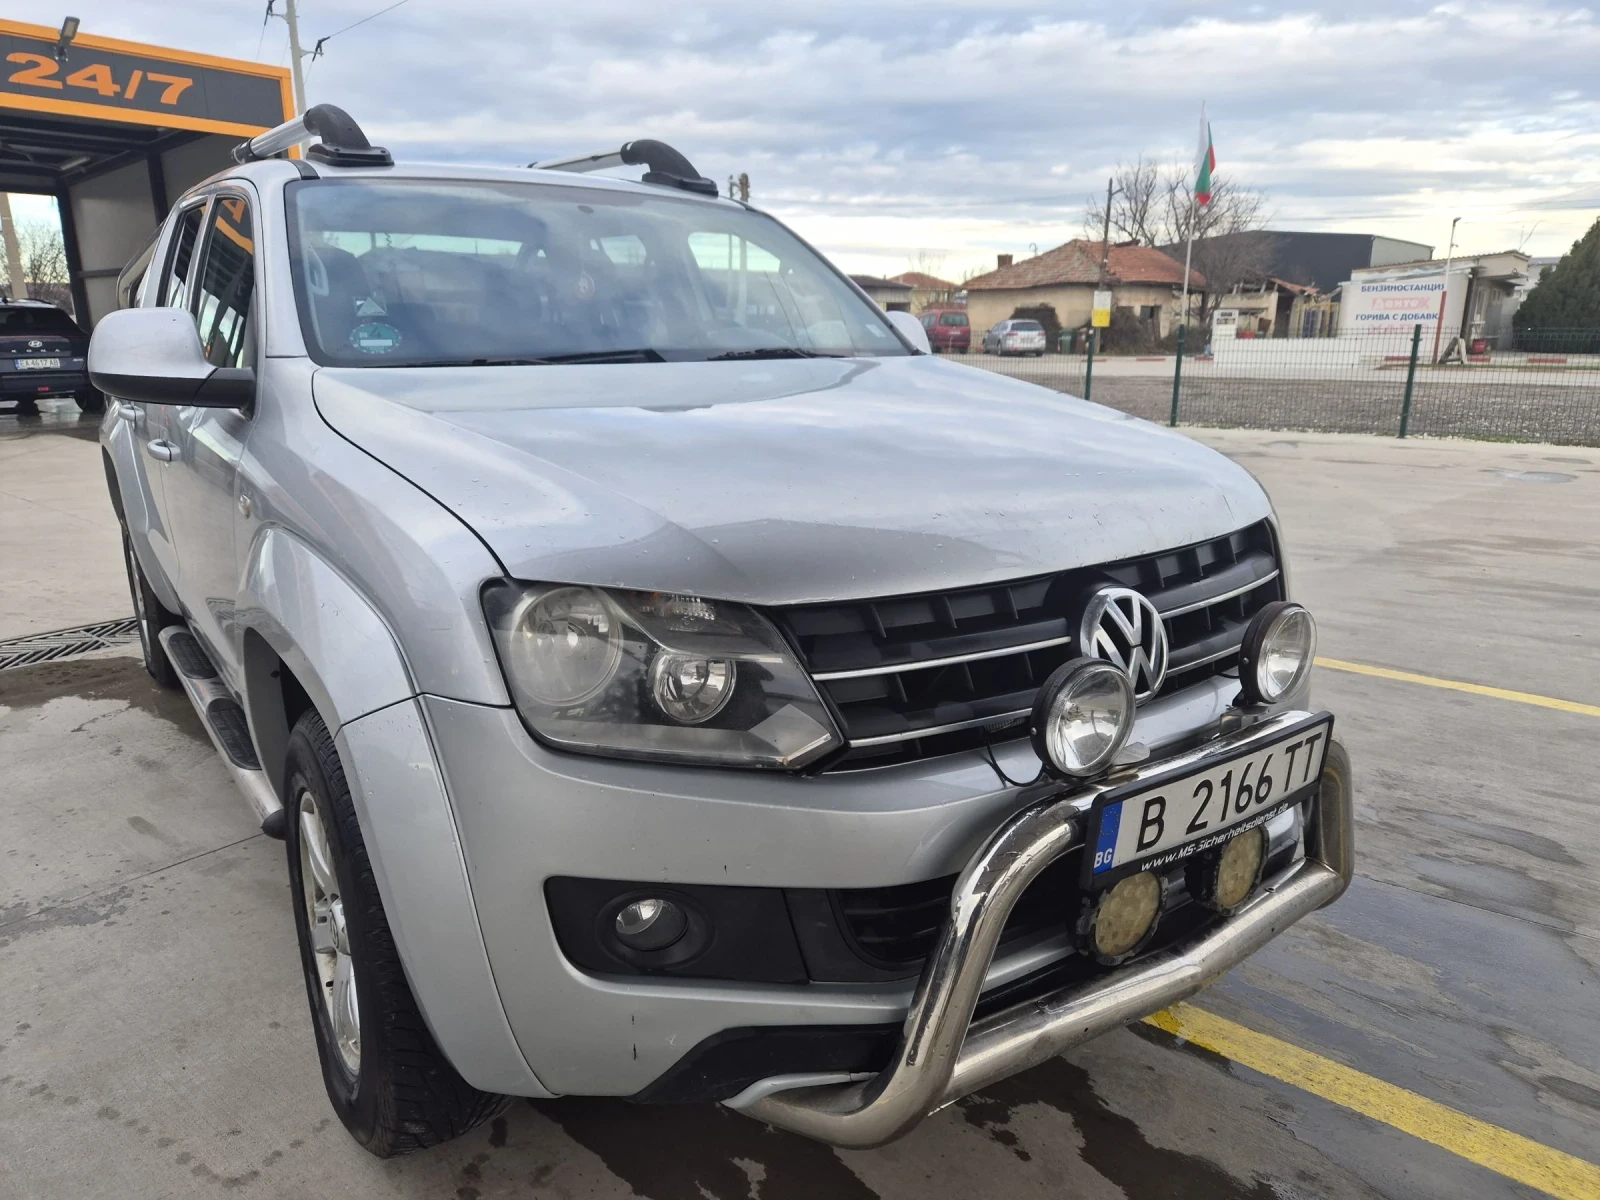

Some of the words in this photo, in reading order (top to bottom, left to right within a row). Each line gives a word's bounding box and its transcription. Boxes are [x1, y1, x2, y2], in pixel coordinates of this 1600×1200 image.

[6, 52, 193, 105] 24/7
[1356, 313, 1390, 321] ГОРИВА
[1393, 313, 1399, 321] С
[1400, 312, 1438, 321] ДОБАВК
[1136, 796, 1166, 853] B
[1186, 753, 1273, 835] 2166
[1283, 732, 1322, 792] TT
[1094, 848, 1113, 868] BG
[1141, 802, 1289, 871] www.MS-Sicherheitsdienst.de
